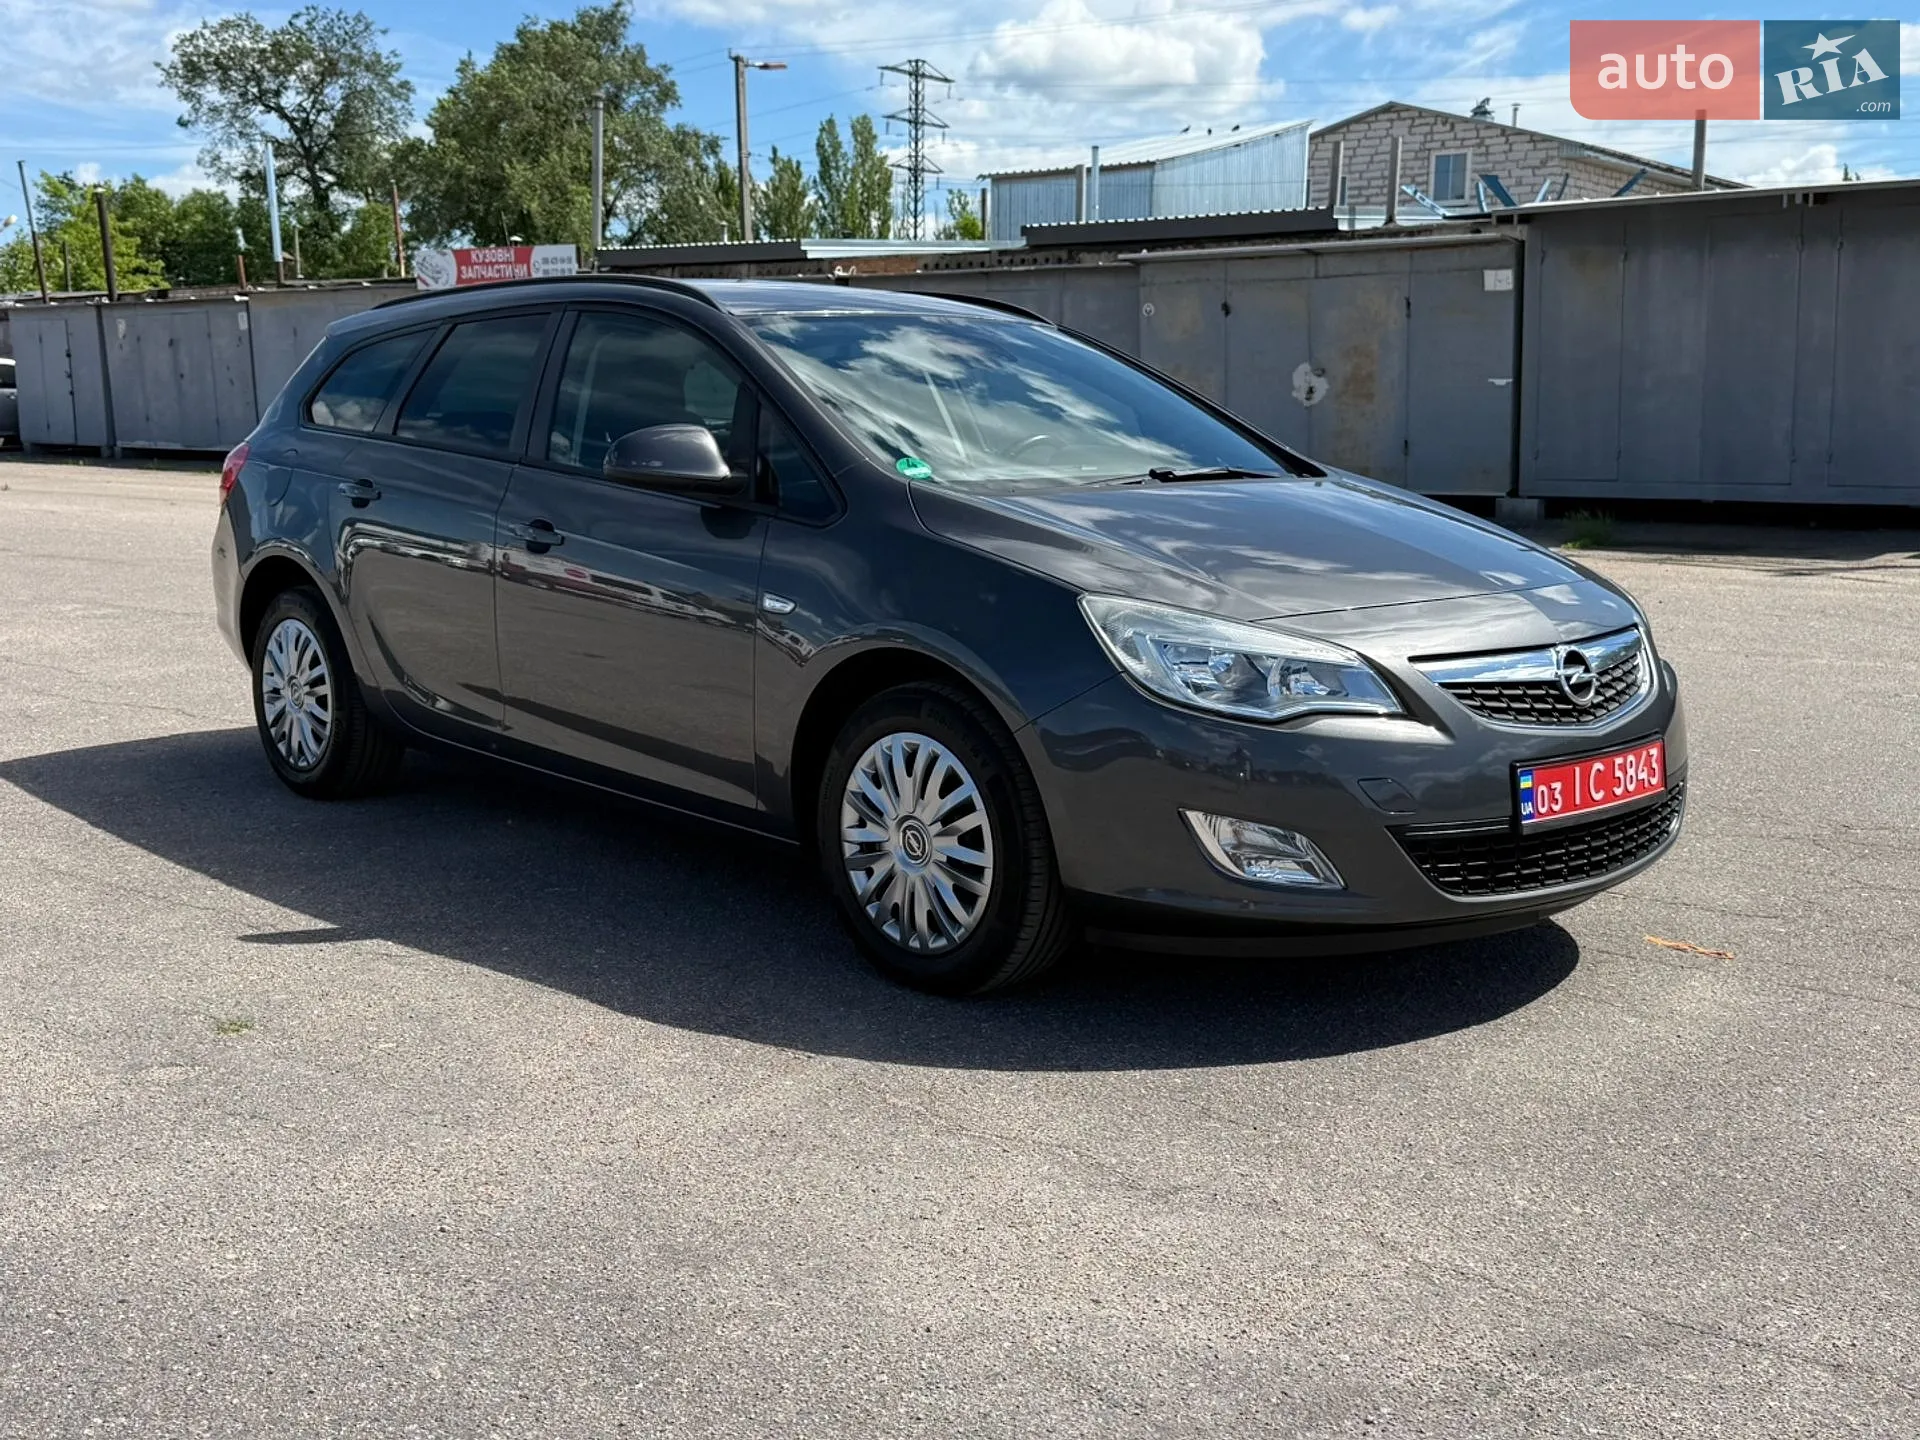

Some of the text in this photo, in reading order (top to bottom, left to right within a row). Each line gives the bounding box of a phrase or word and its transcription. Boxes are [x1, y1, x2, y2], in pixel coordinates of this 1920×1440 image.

[470, 247, 515, 263] КУЗОВНІ
[1537, 781, 1563, 814] 03
[1612, 747, 1659, 796] 5843
[1521, 803, 1534, 815] UA
